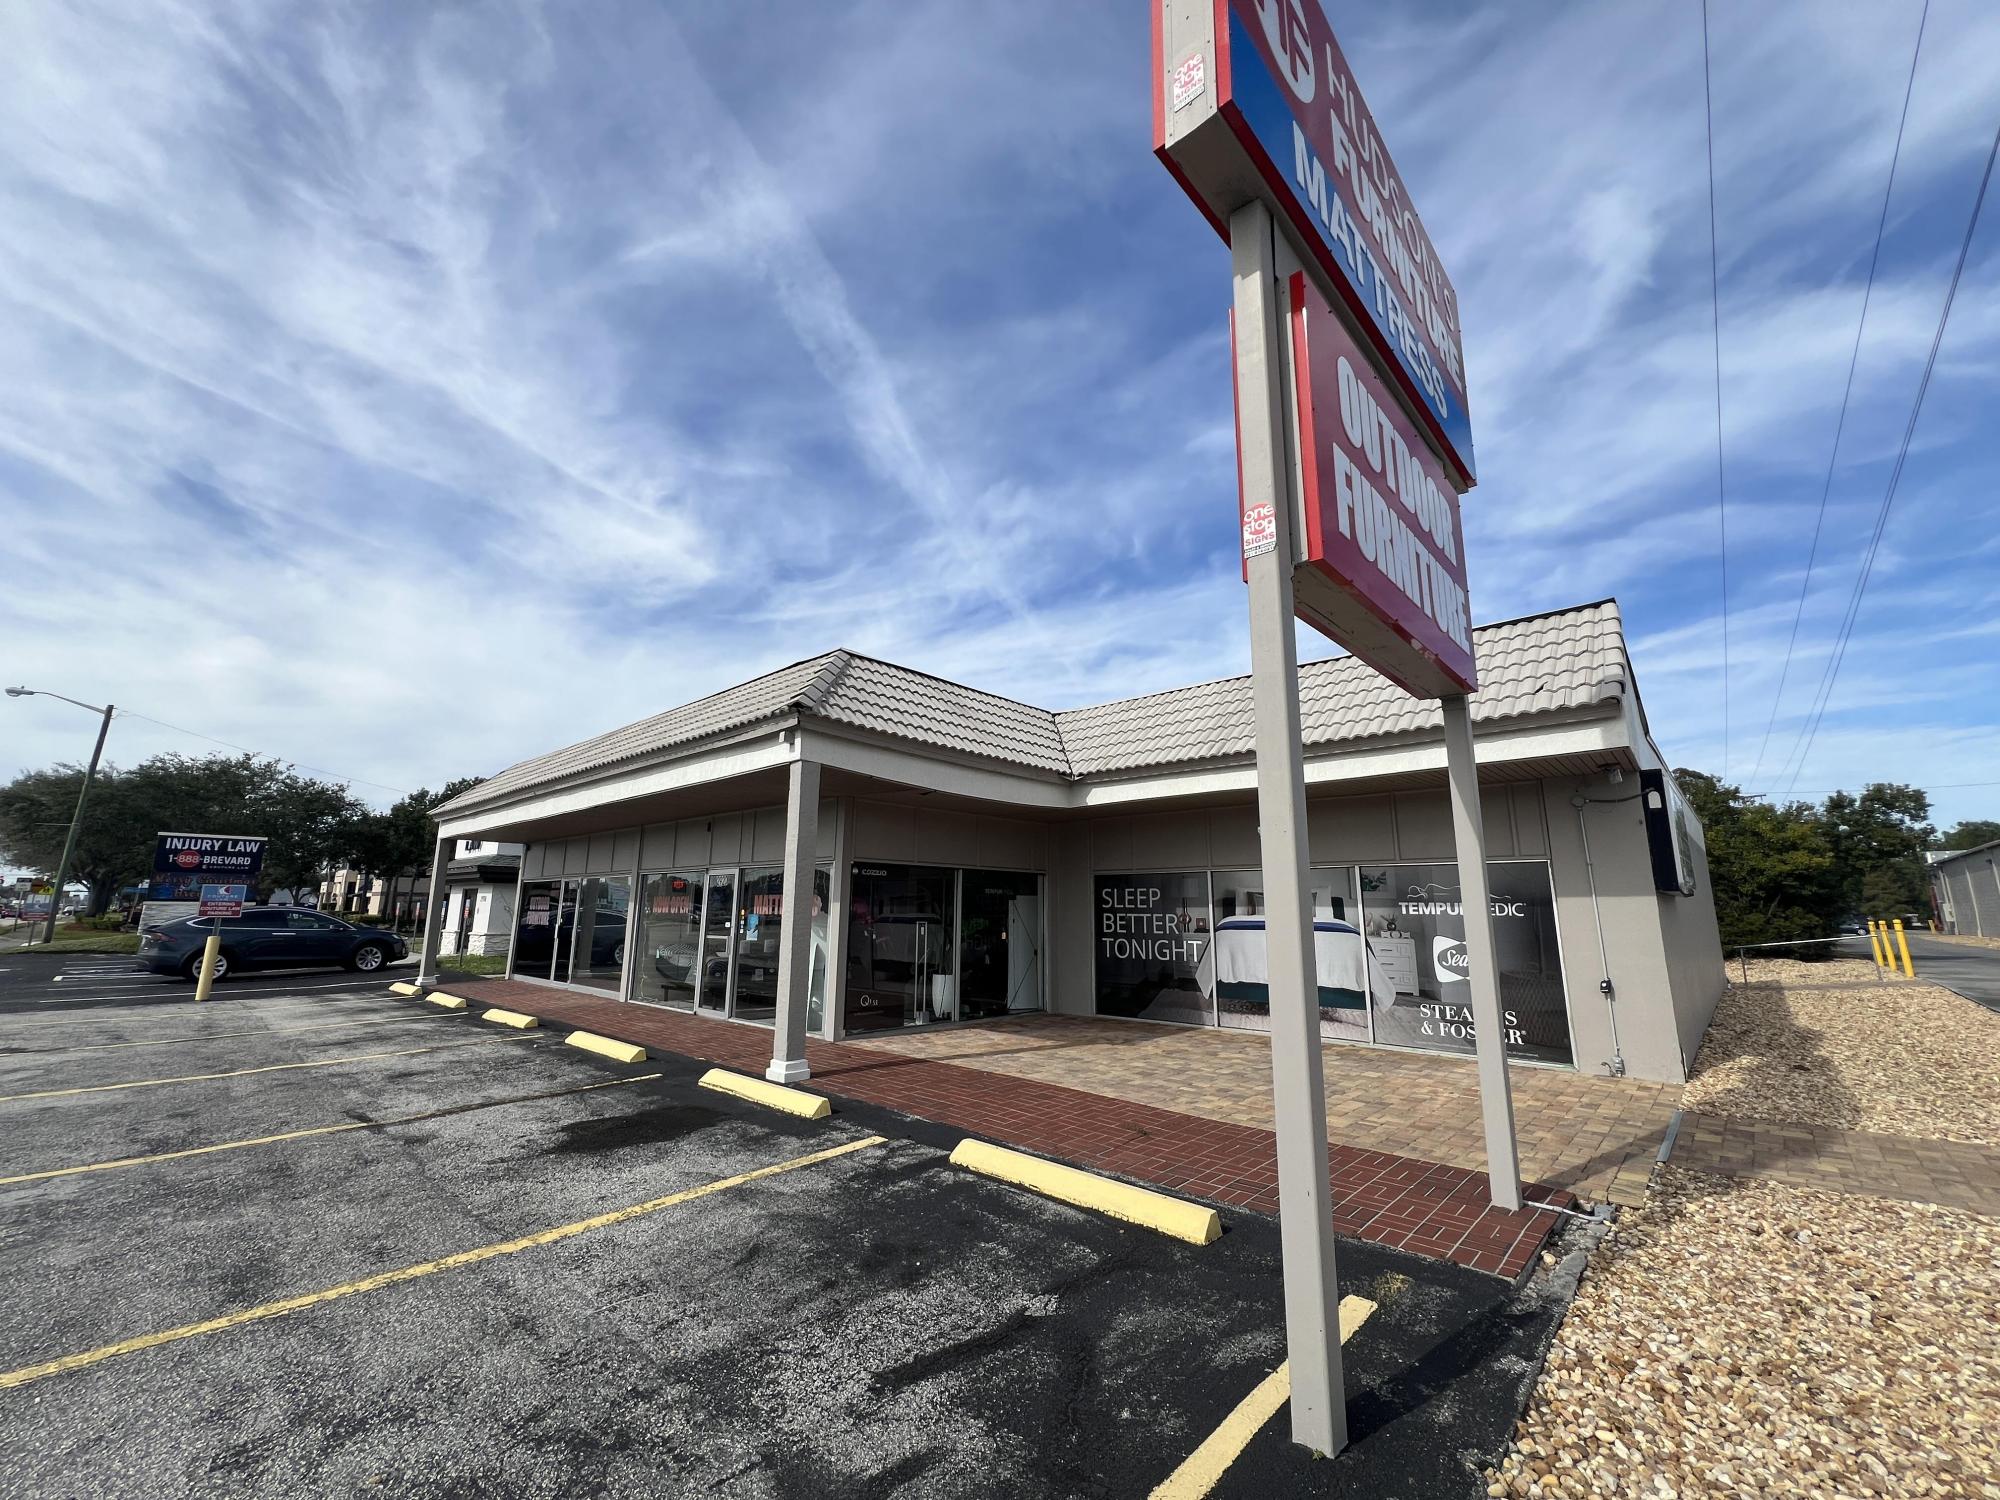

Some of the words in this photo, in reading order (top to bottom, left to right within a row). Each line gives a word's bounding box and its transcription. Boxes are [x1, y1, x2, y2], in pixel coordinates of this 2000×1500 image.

[1326, 42, 1454, 331] HUDSON'S
[1331, 108, 1463, 394] FURNITURE
[1292, 120, 1448, 419] MATTRESS
[1337, 356, 1457, 567] OUTDOOR
[1244, 505, 1275, 522] one
[1245, 531, 1276, 547] SIGNS
[1333, 442, 1470, 656] FURNITURE
[165, 837, 222, 852] INJURY
[227, 841, 260, 853] LAW
[168, 854, 251, 865] 1-888-BREVARD
[652, 896, 670, 913] NOW
[1102, 888, 1161, 909] SLEEP
[1103, 913, 1179, 934] BETTER
[1101, 938, 1202, 962] TONIGHT
[1420, 1003, 1518, 1026] STEAS
[1421, 1021, 1434, 1036] &
